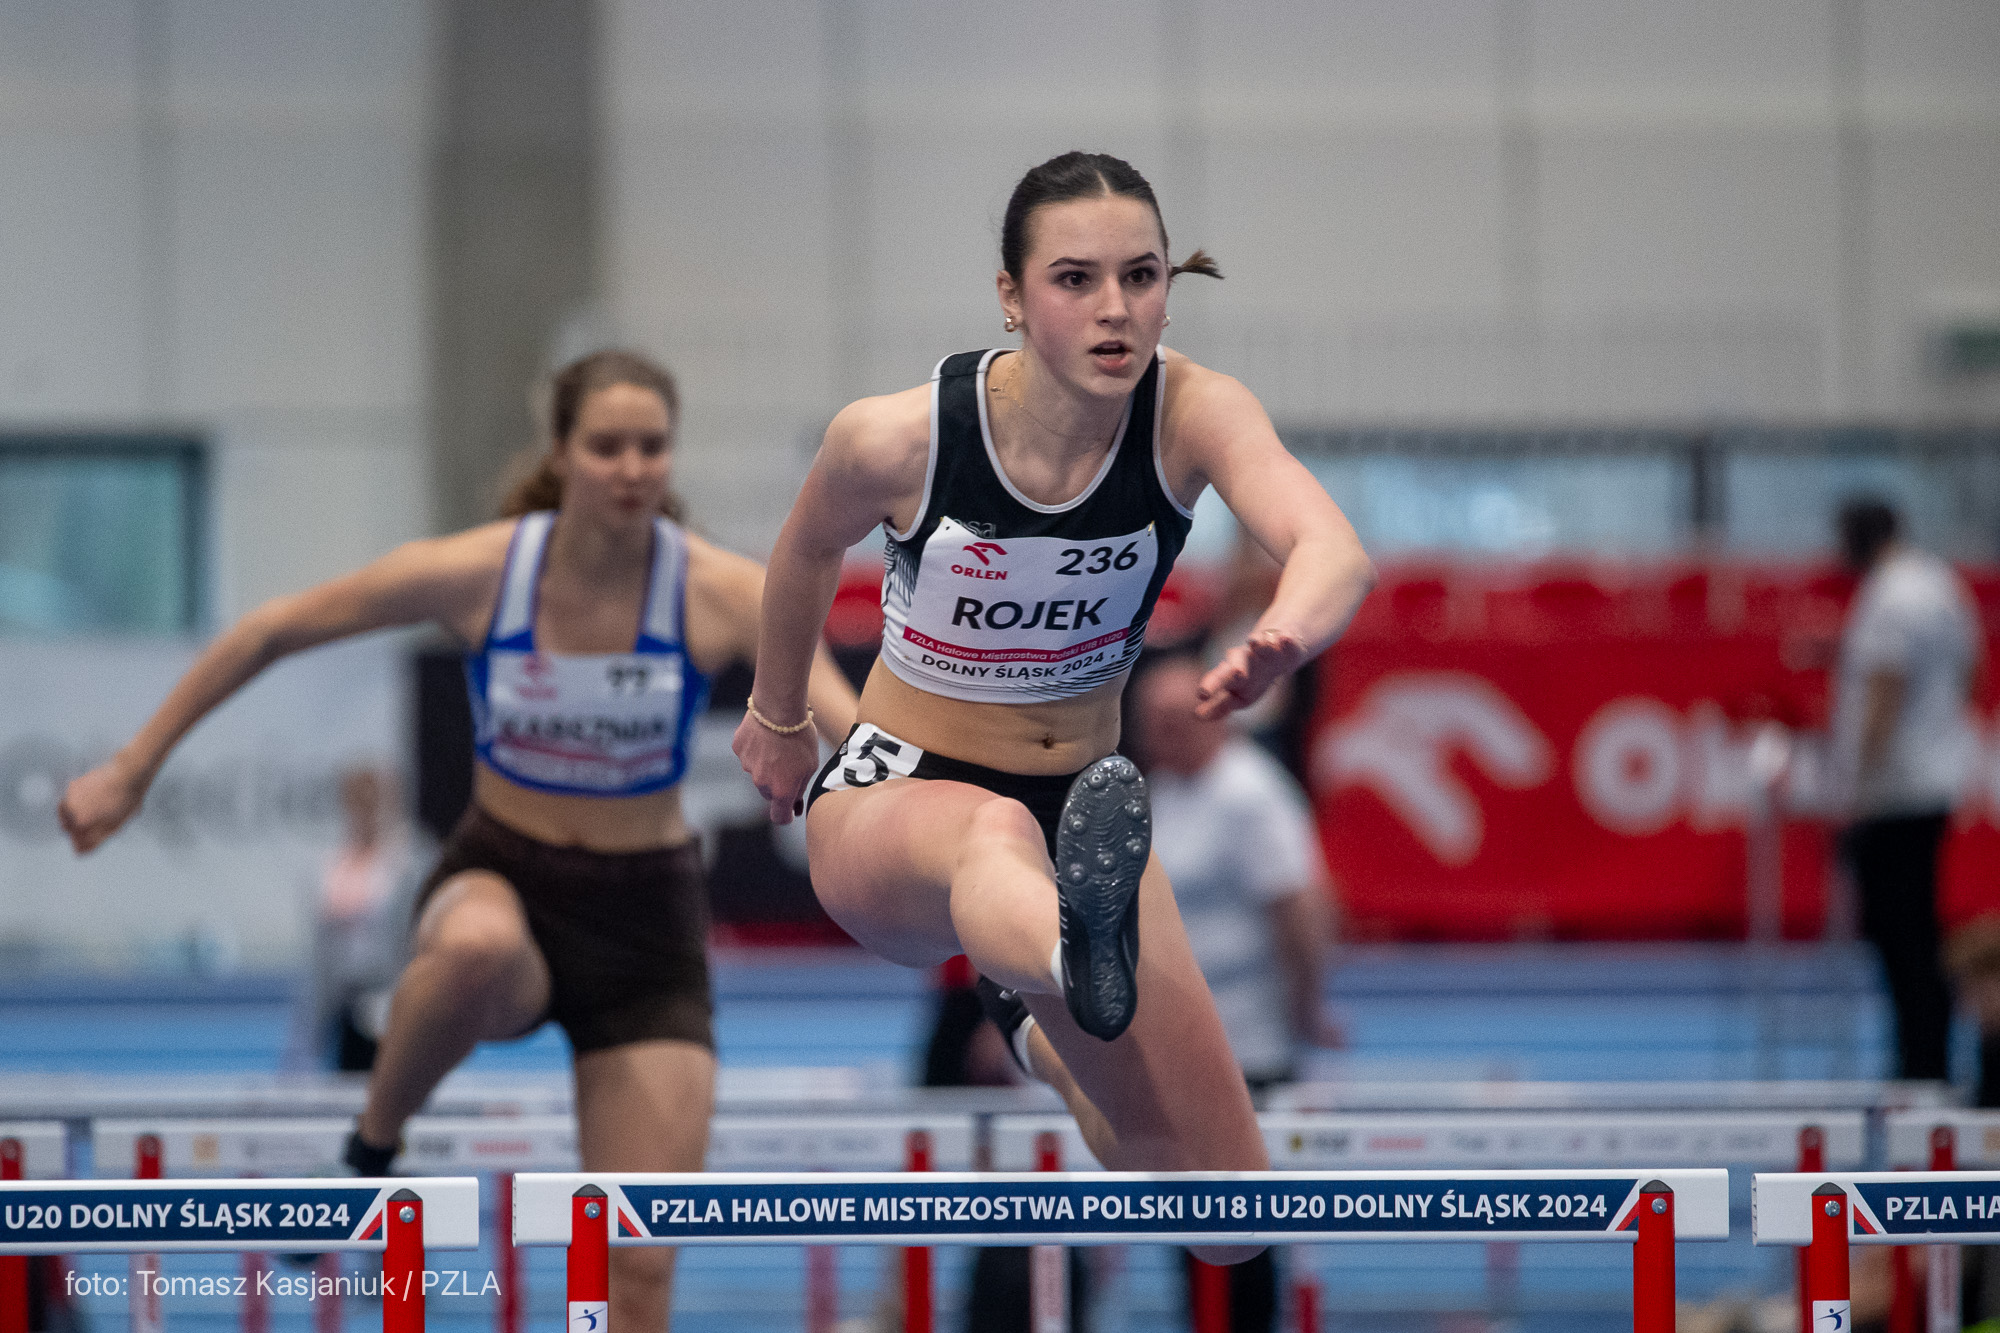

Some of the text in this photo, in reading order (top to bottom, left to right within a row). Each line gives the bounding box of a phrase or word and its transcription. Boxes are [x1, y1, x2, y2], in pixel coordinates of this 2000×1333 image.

[951, 564, 1008, 580] ORLEN
[1055, 541, 1138, 576] 236
[951, 597, 1109, 630] ROJEK
[910, 632, 935, 649] PZLA
[936, 645, 979, 659] Halowe
[981, 651, 1047, 660] Mistrzostwa
[1049, 646, 1079, 660] Polski
[1080, 642, 1098, 652] U18
[1104, 632, 1123, 643] U20
[921, 652, 1104, 680] DOLNY ŚLĄSK 2024
[843, 732, 902, 788] 5
[5, 1199, 350, 1234] U20 DOLNY ŚLĄSK 2024
[651, 1189, 1607, 1224] PZLA HALOWE MISTRZOSTWA POLSKI U18 i U20 DOLNY ŚLĄSK 2024
[1886, 1196, 1958, 1220] PZLA
